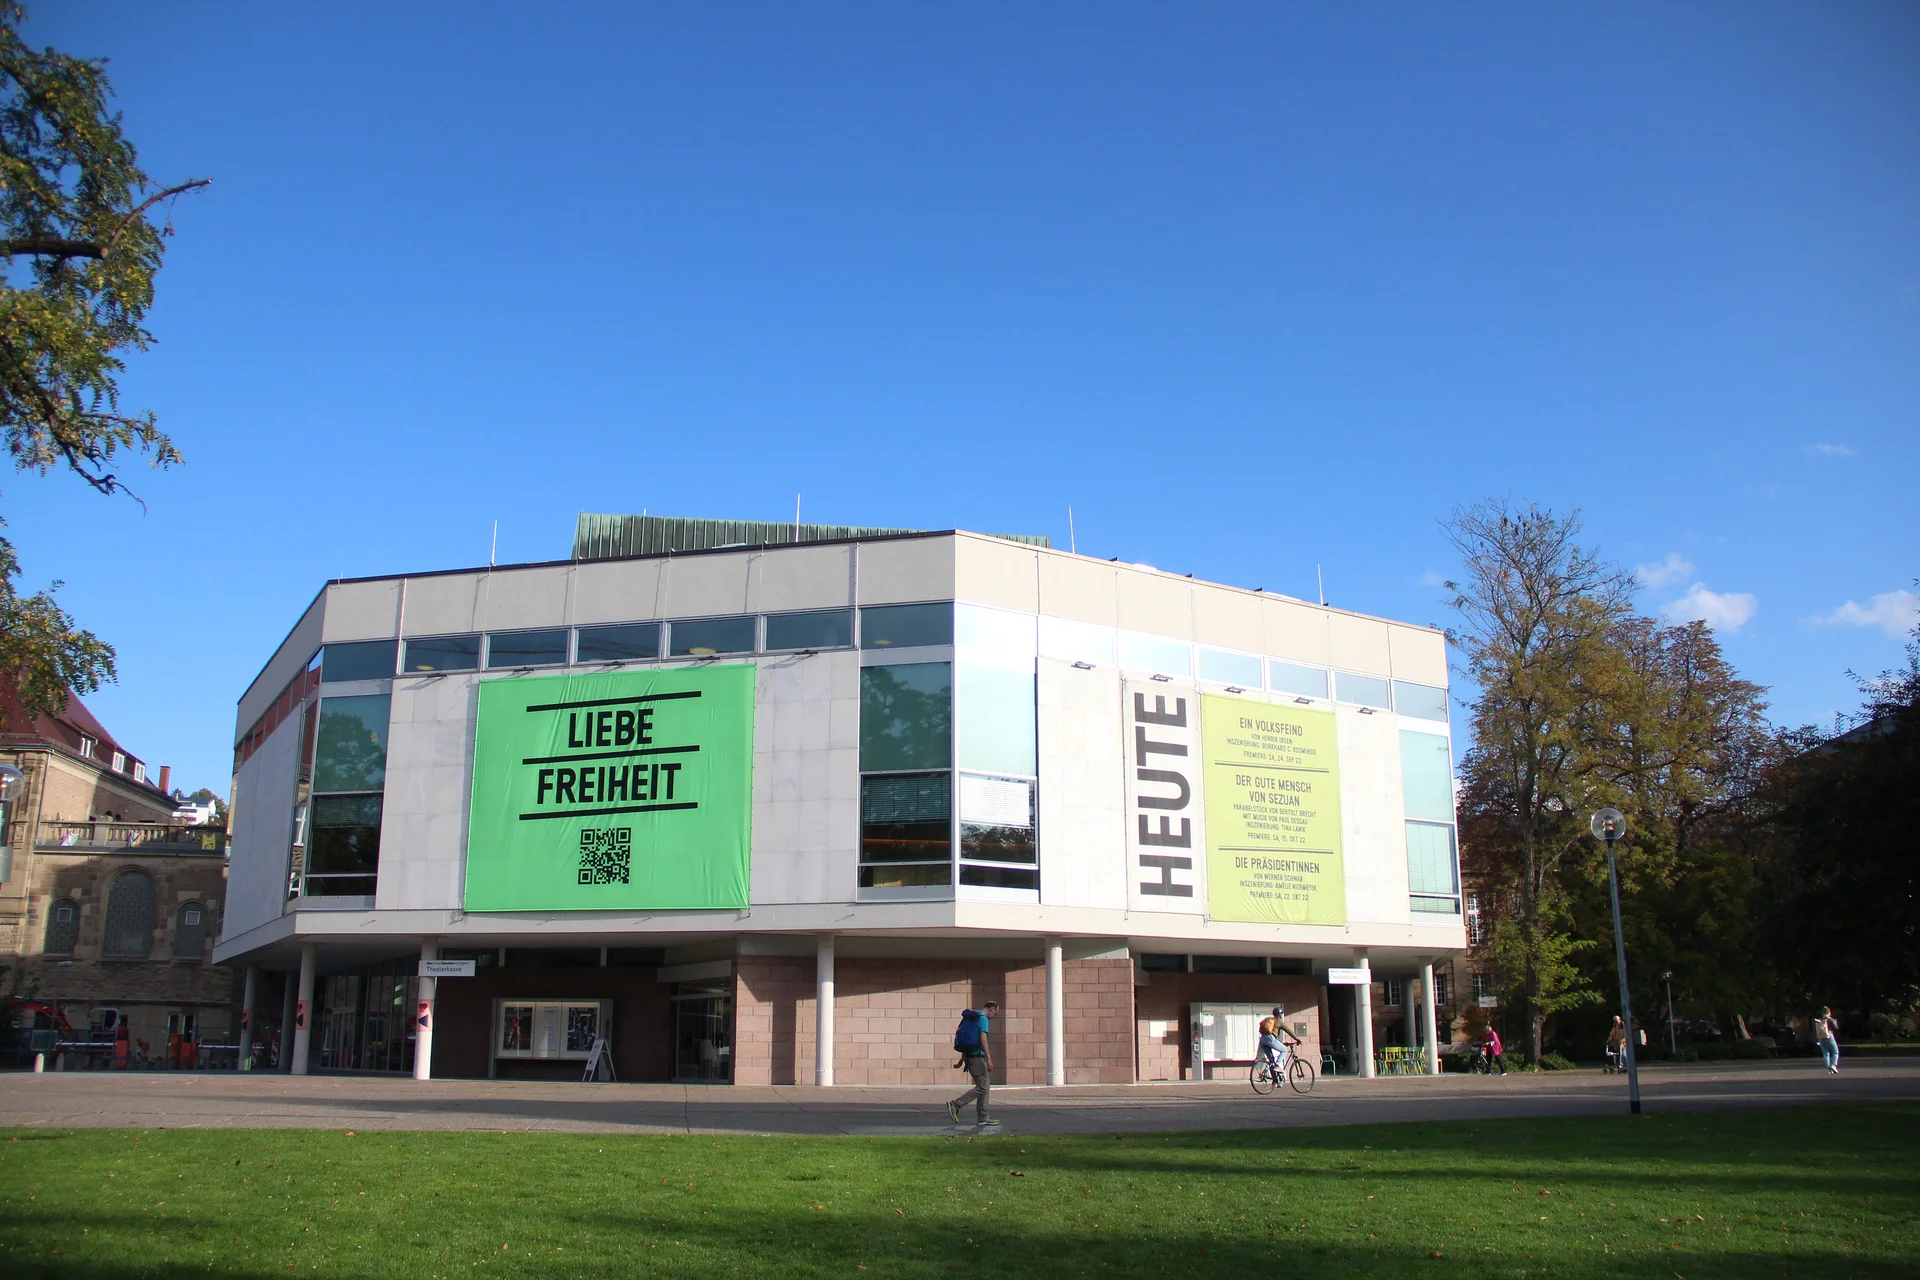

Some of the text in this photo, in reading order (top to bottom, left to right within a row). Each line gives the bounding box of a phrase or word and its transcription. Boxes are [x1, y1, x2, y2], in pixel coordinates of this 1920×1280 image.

[569, 709, 653, 748] LIEBE
[1240, 717, 1303, 736] EIN VOLKSFEIND
[1244, 751, 1267, 760] PREMIERE:
[1262, 743, 1286, 751] BURKHARD
[1293, 747, 1317, 755] KOSMINSKI
[537, 763, 681, 804] FREIHEIT
[1236, 774, 1312, 793] DER GUTE MENSCH
[1134, 692, 1193, 898] HEUTE
[1249, 791, 1300, 806] VON SEZUAN
[1233, 803, 1268, 812] PARABELSTÜCK
[1246, 822, 1280, 830] INSZENIERUNG:
[1248, 832, 1271, 840] PREMIERE:
[1235, 857, 1320, 873] DIE PRÄSIDENTINNEN
